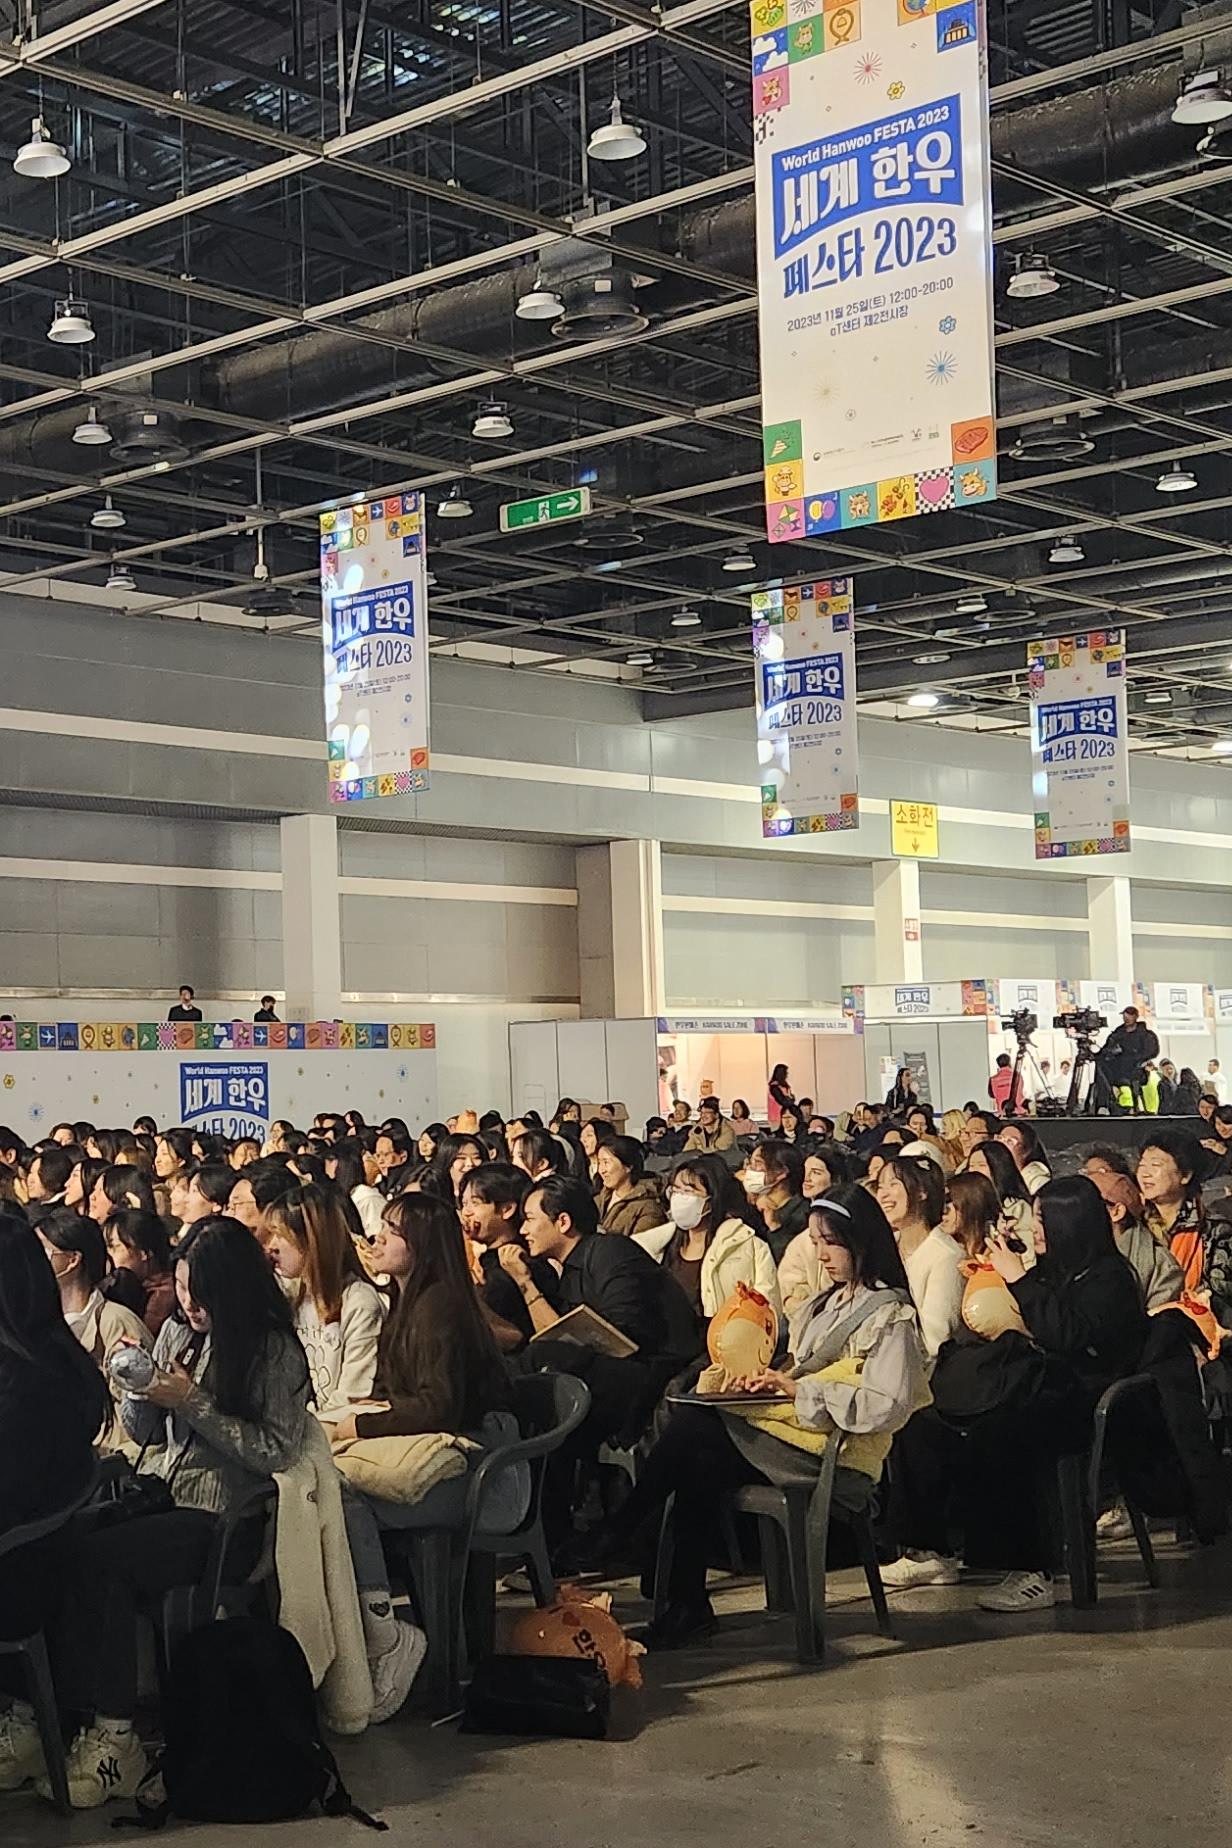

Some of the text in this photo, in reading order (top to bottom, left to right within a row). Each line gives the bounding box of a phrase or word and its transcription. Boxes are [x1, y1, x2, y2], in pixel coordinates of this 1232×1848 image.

[781, 106, 950, 171] World Hanwoo FESTA 2023
[781, 131, 956, 245] 세계 한우
[783, 216, 957, 299] 페스타 2023
[787, 312, 822, 332] 2023년
[825, 307, 844, 322] 11월
[889, 276, 954, 304] 12:00-20:00
[374, 597, 412, 631] 한우
[376, 640, 412, 667] 2023
[805, 666, 842, 694] 한우
[807, 701, 842, 724] 2023
[1079, 708, 1115, 732] 한우
[1080, 739, 1115, 759] 2023
[896, 804, 933, 828] 소화전
[184, 1077, 266, 1116] 세계 한우
[229, 1117, 265, 1144] 2023
